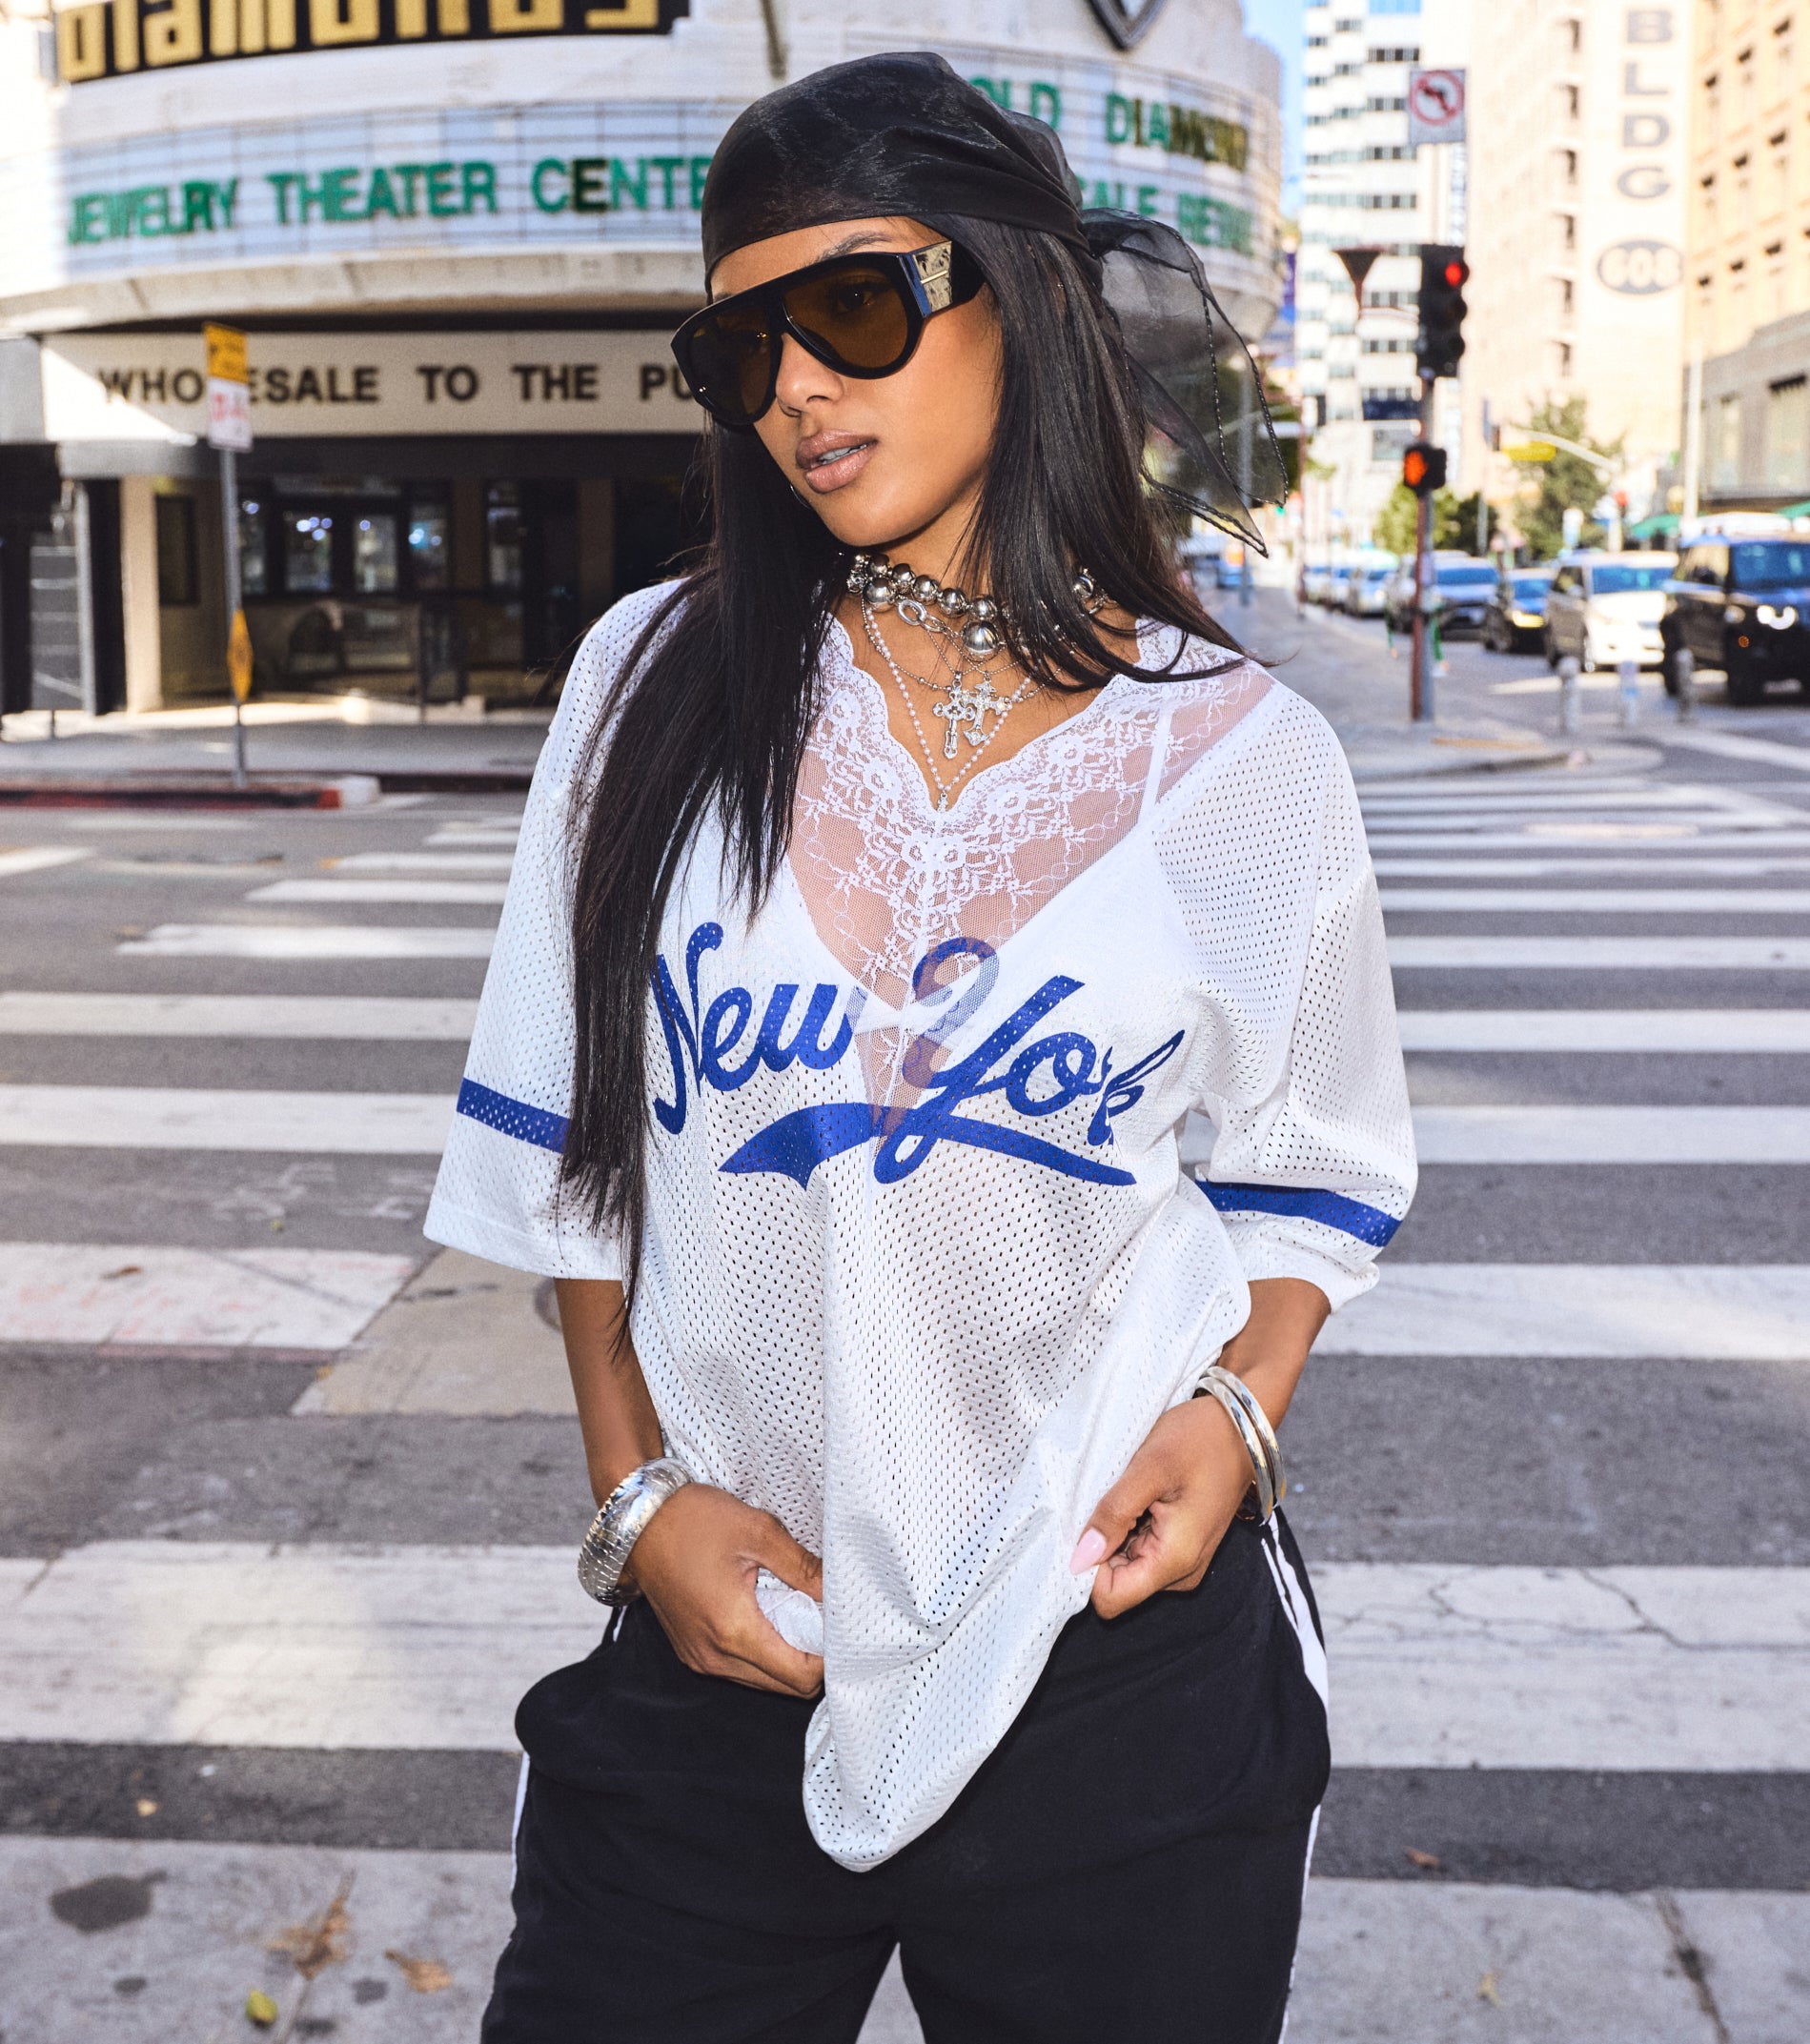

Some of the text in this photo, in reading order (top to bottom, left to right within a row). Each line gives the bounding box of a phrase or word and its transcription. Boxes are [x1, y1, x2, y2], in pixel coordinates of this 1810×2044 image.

[1617, 10, 1673, 199] BLDG
[68, 156, 715, 246] JEWELRY THEATER CENTE
[417, 364, 480, 402] TO
[512, 364, 600, 401] THE
[649, 921, 868, 1135] New
